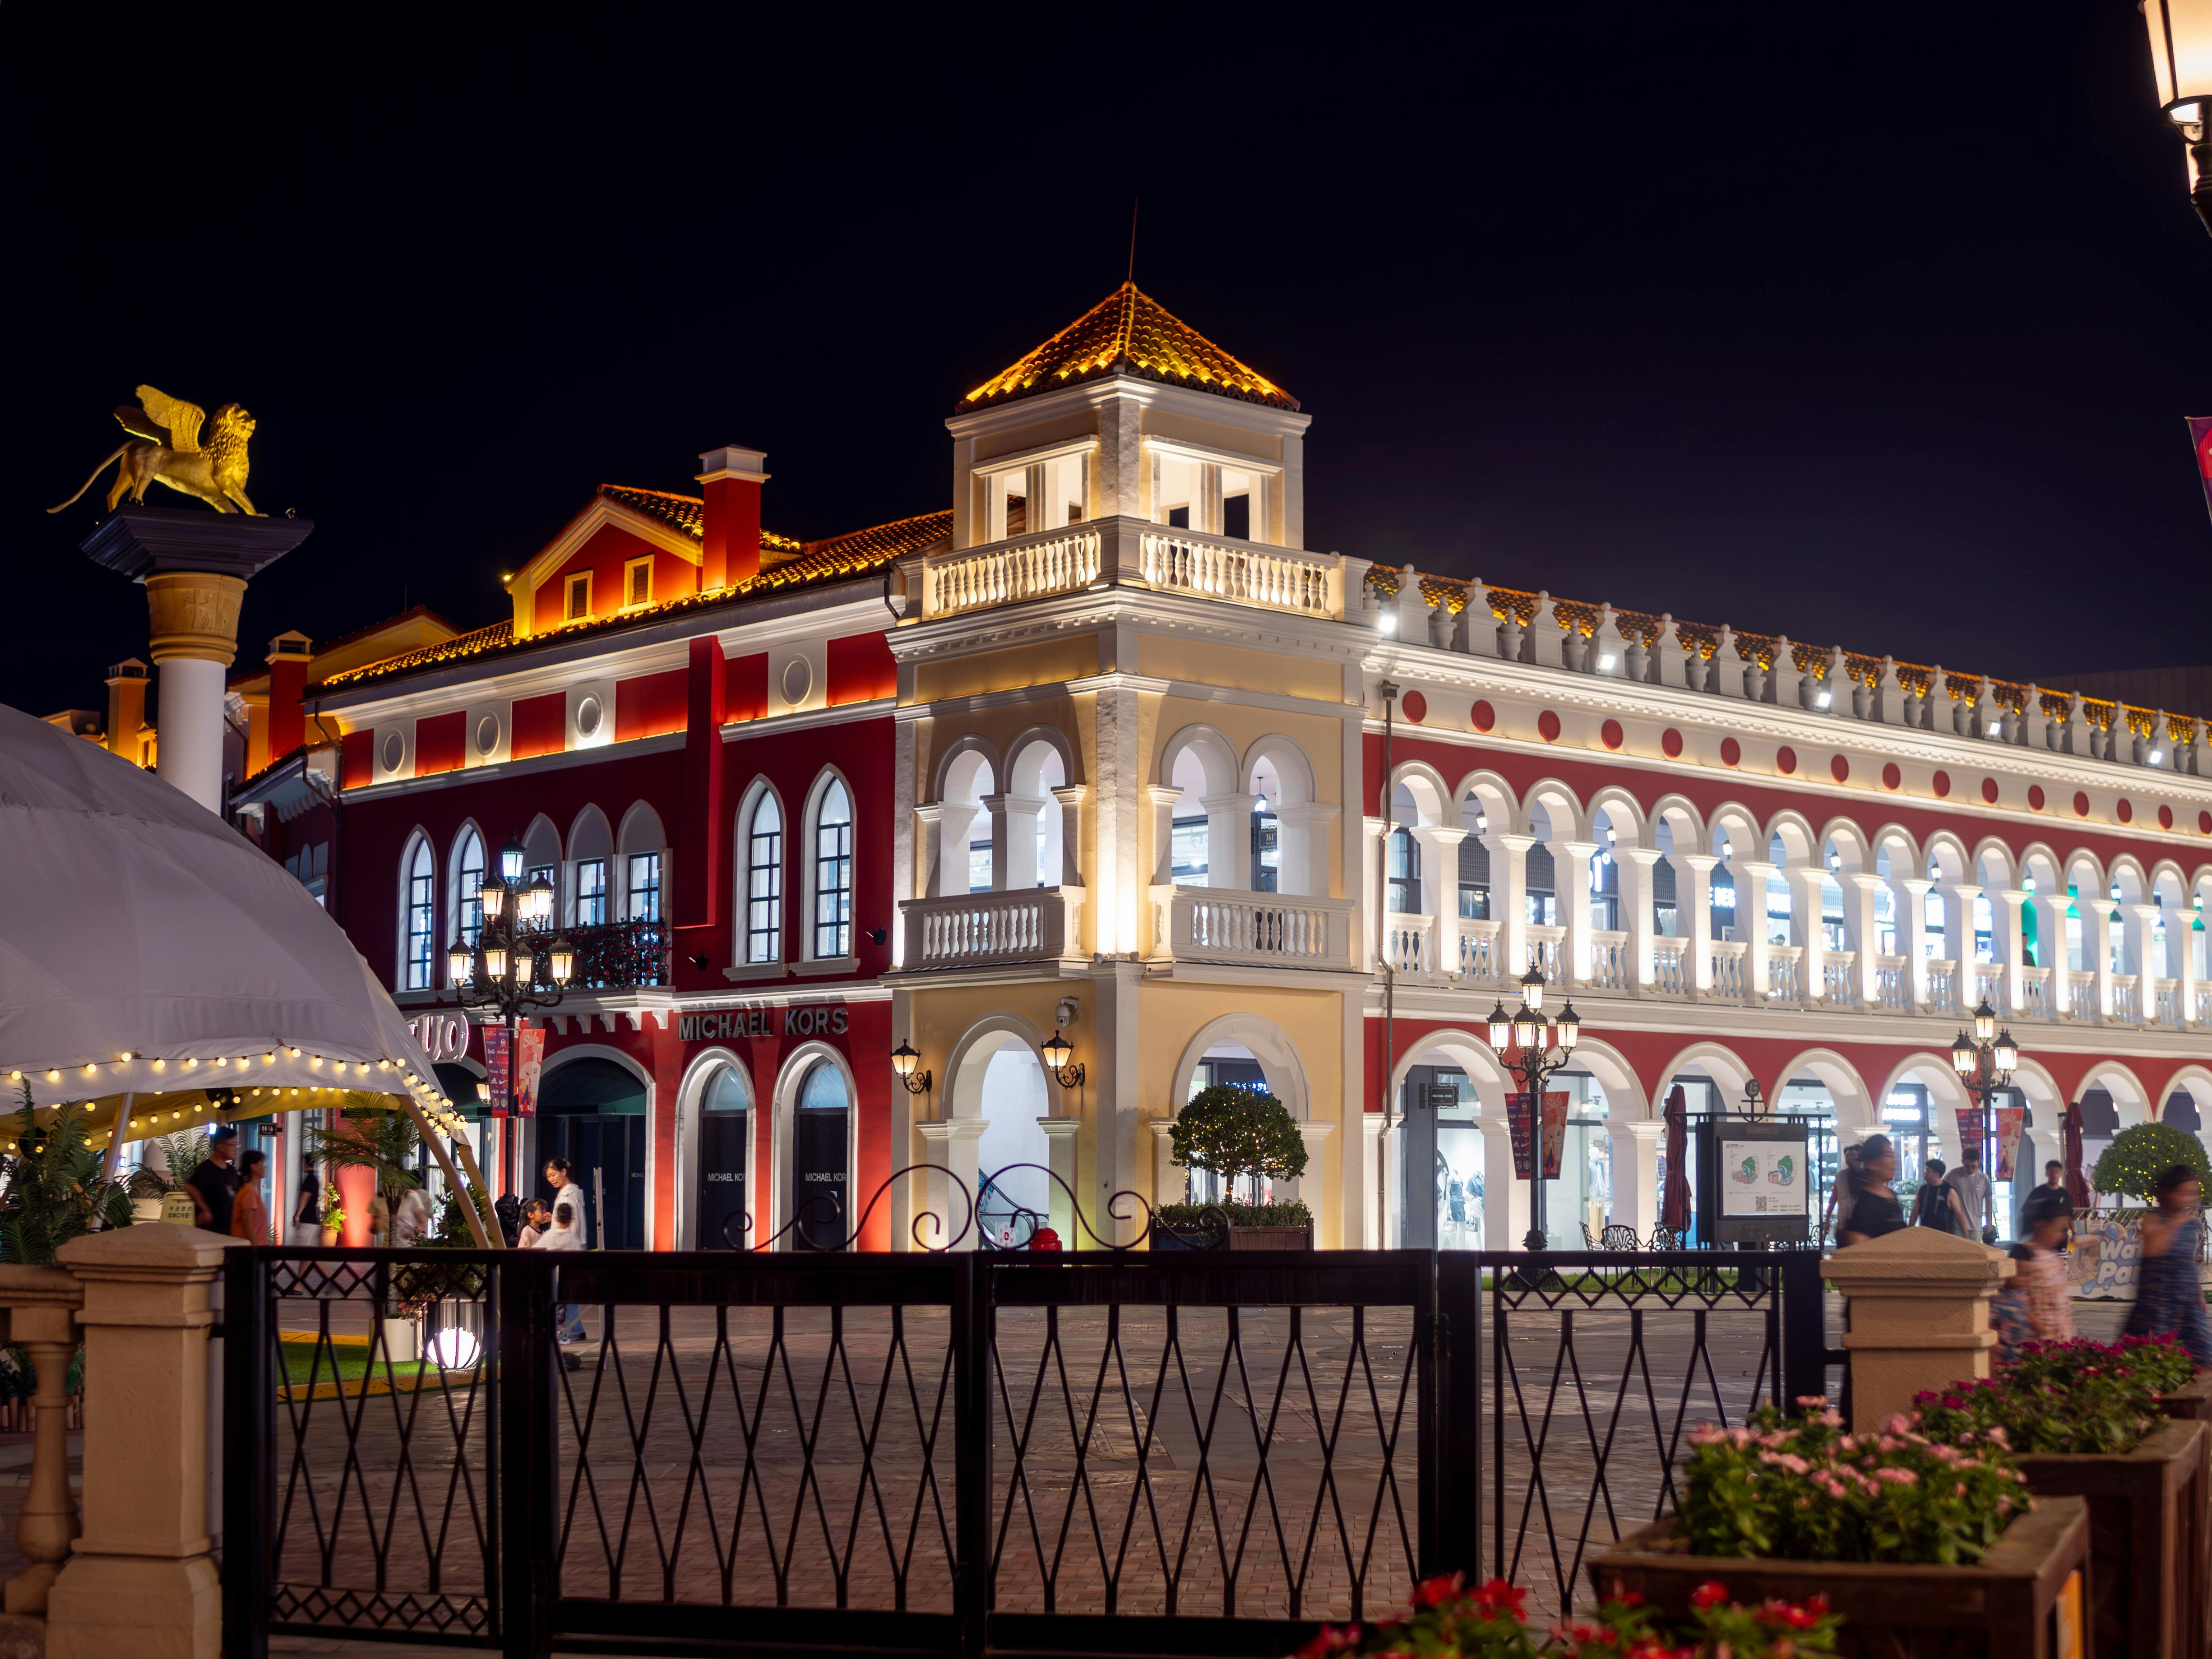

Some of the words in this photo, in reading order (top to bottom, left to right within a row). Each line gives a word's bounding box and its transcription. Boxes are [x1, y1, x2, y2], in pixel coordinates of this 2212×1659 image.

[678, 1012, 773, 1040] MICHAEL
[785, 1007, 848, 1035] KORS
[523, 1031, 540, 1048] Sale
[1546, 1093, 1563, 1111] Sale
[708, 1173, 733, 1181] MICHAEL
[805, 1173, 832, 1181] MICHAEL
[833, 1173, 847, 1181] KOR
[2100, 1240, 2143, 1260] Wat
[2097, 1262, 2141, 1285] Par
